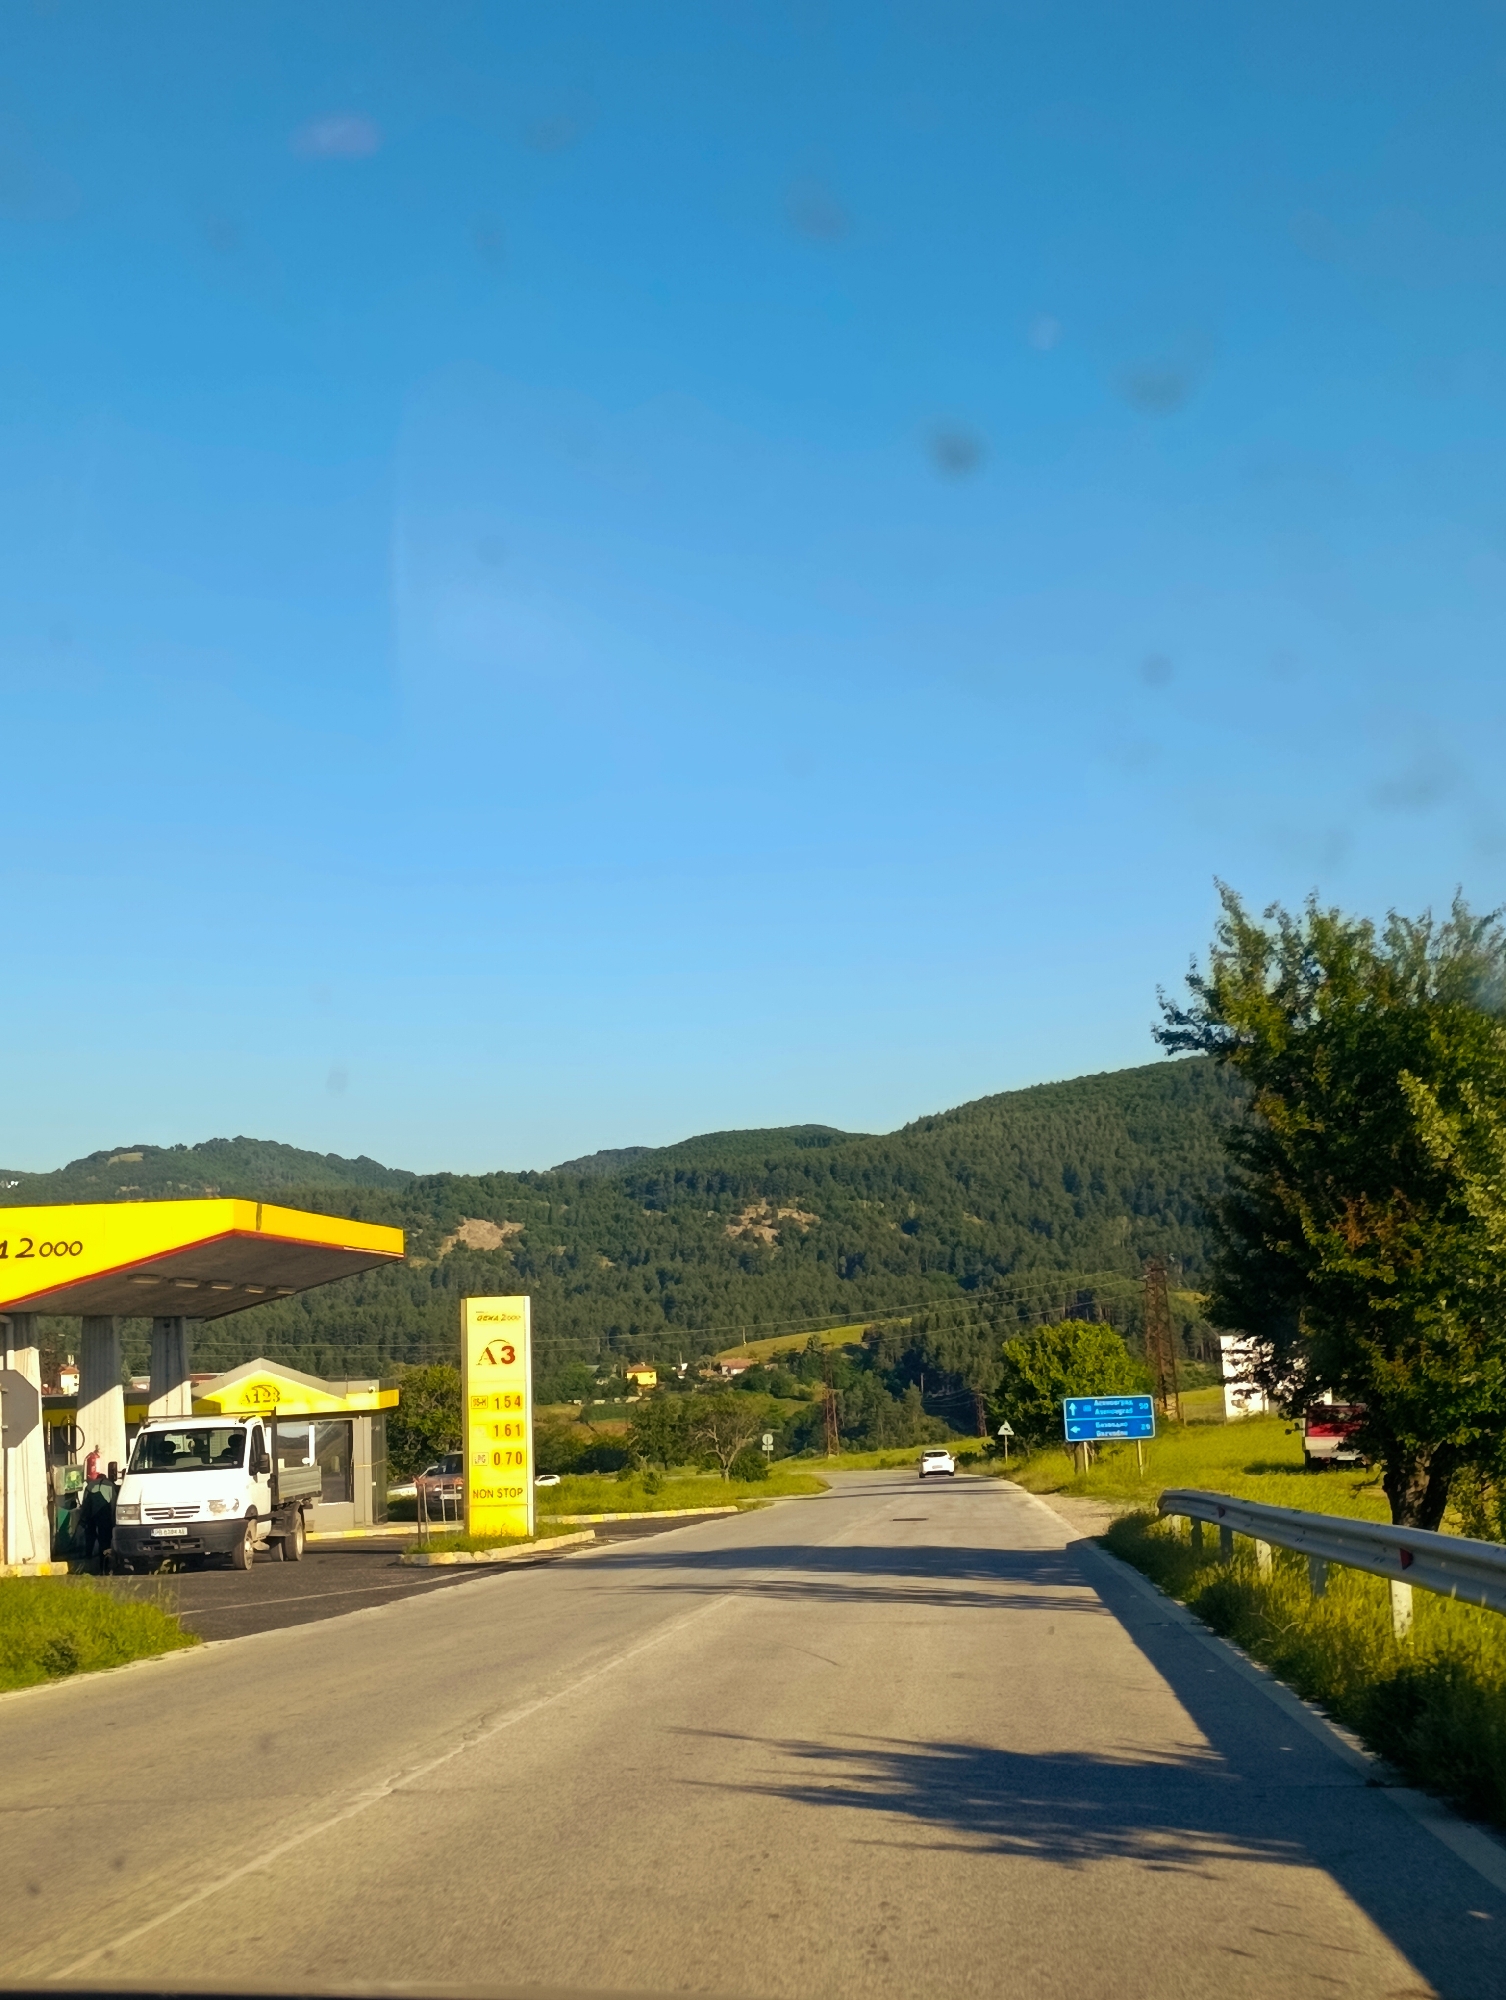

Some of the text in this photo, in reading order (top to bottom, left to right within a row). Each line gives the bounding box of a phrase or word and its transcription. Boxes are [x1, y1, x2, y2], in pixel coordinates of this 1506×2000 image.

[15, 1237, 83, 1258] 2000
[472, 1489, 494, 1499] NON
[496, 1487, 524, 1498] STOP
